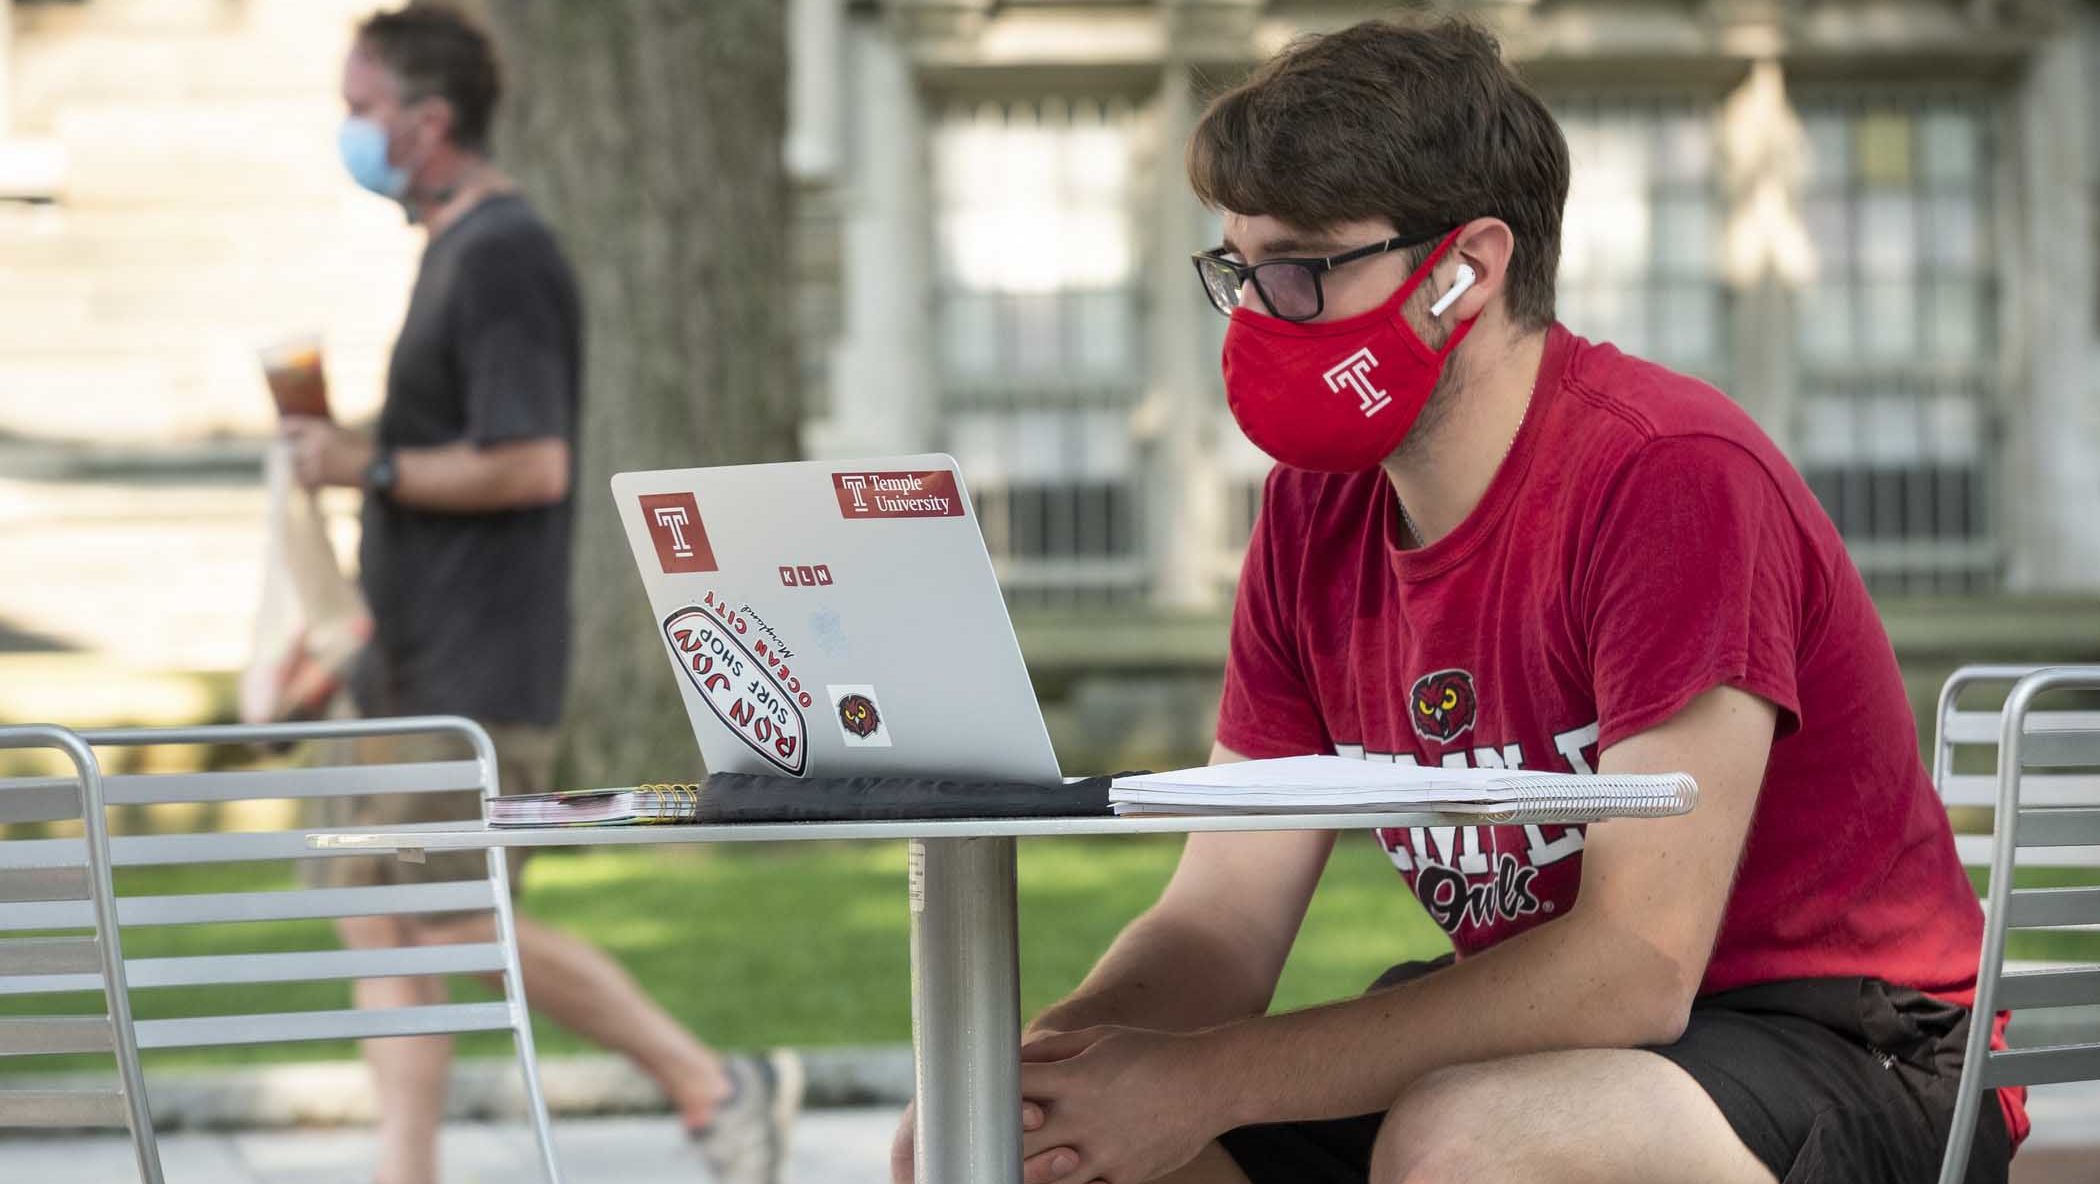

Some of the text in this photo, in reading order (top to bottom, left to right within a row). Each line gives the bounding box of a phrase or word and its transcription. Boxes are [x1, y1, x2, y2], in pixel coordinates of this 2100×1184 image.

[1322, 347, 1393, 418] T
[842, 475, 869, 512] T
[869, 473, 923, 496] Temple
[874, 494, 950, 515] University
[654, 507, 694, 557] T
[704, 590, 813, 708] OCEAN CITY
[740, 604, 795, 659] Maryland
[673, 629, 797, 759] RON JON
[700, 629, 789, 725] SURF SHOP
